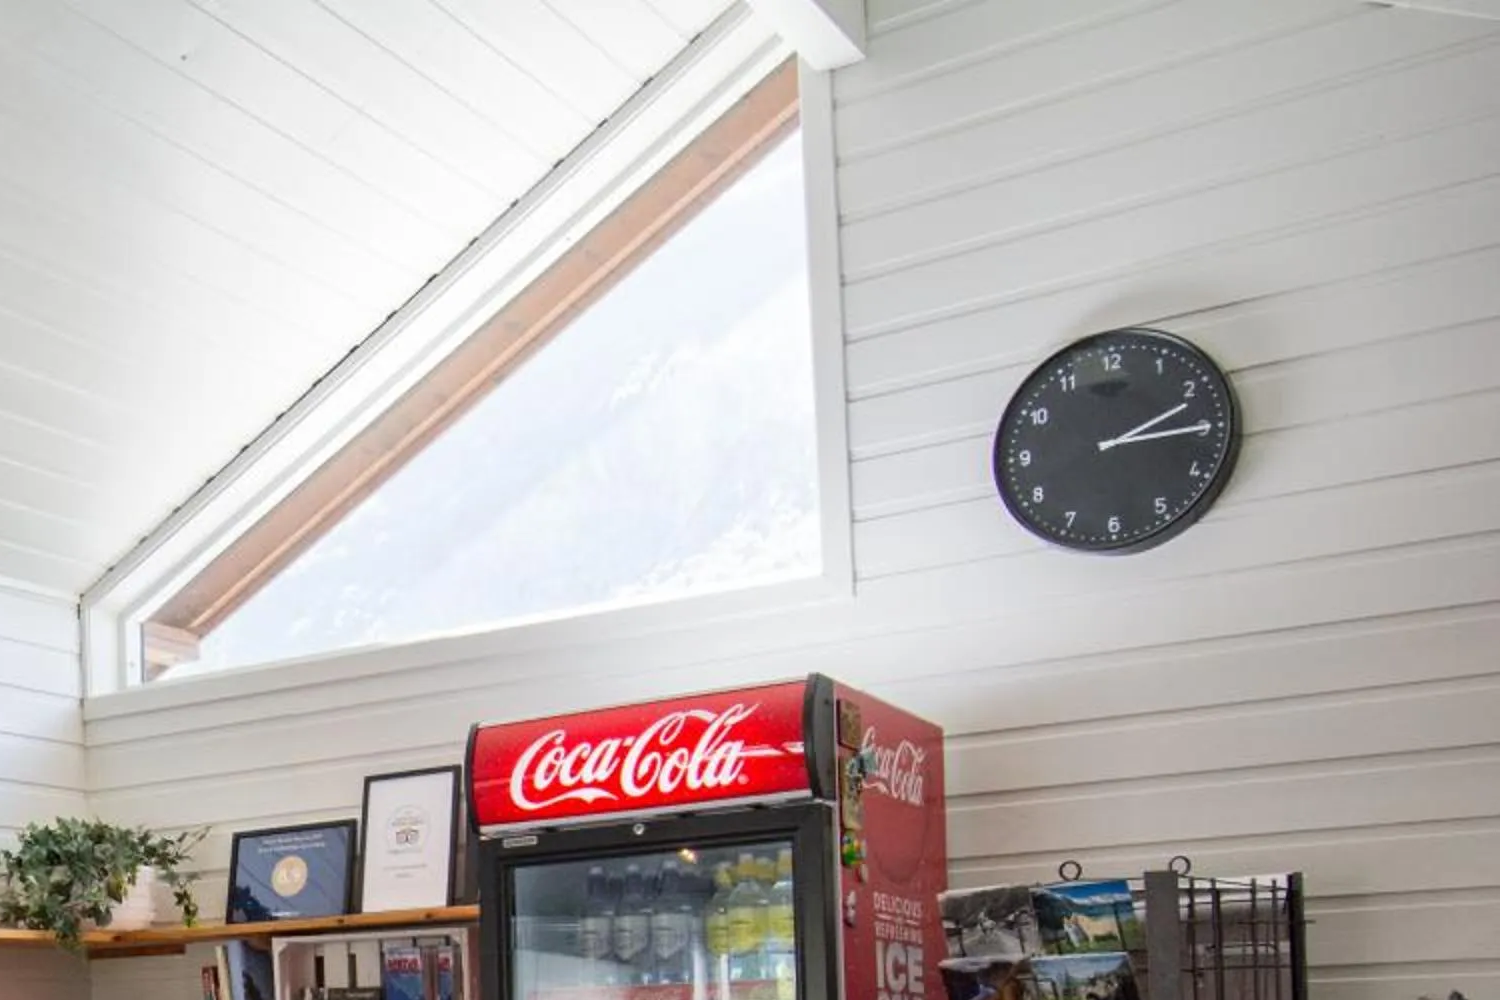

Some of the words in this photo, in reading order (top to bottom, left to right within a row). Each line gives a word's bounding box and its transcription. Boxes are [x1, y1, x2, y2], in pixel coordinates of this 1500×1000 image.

[1103, 353, 1121, 371] 12
[1155, 359, 1163, 375] 1
[1059, 375, 1076, 392] 11
[1183, 380, 1195, 398] 2
[1030, 407, 1048, 425] 10
[1019, 450, 1031, 467] 9
[1189, 461, 1200, 478] 4
[1033, 486, 1044, 503] 8
[1155, 497, 1167, 514] 5
[1065, 511, 1077, 528] 7
[1108, 516, 1121, 533] 6
[510, 702, 760, 811] Coca-Cola
[875, 939, 924, 994] ICE
